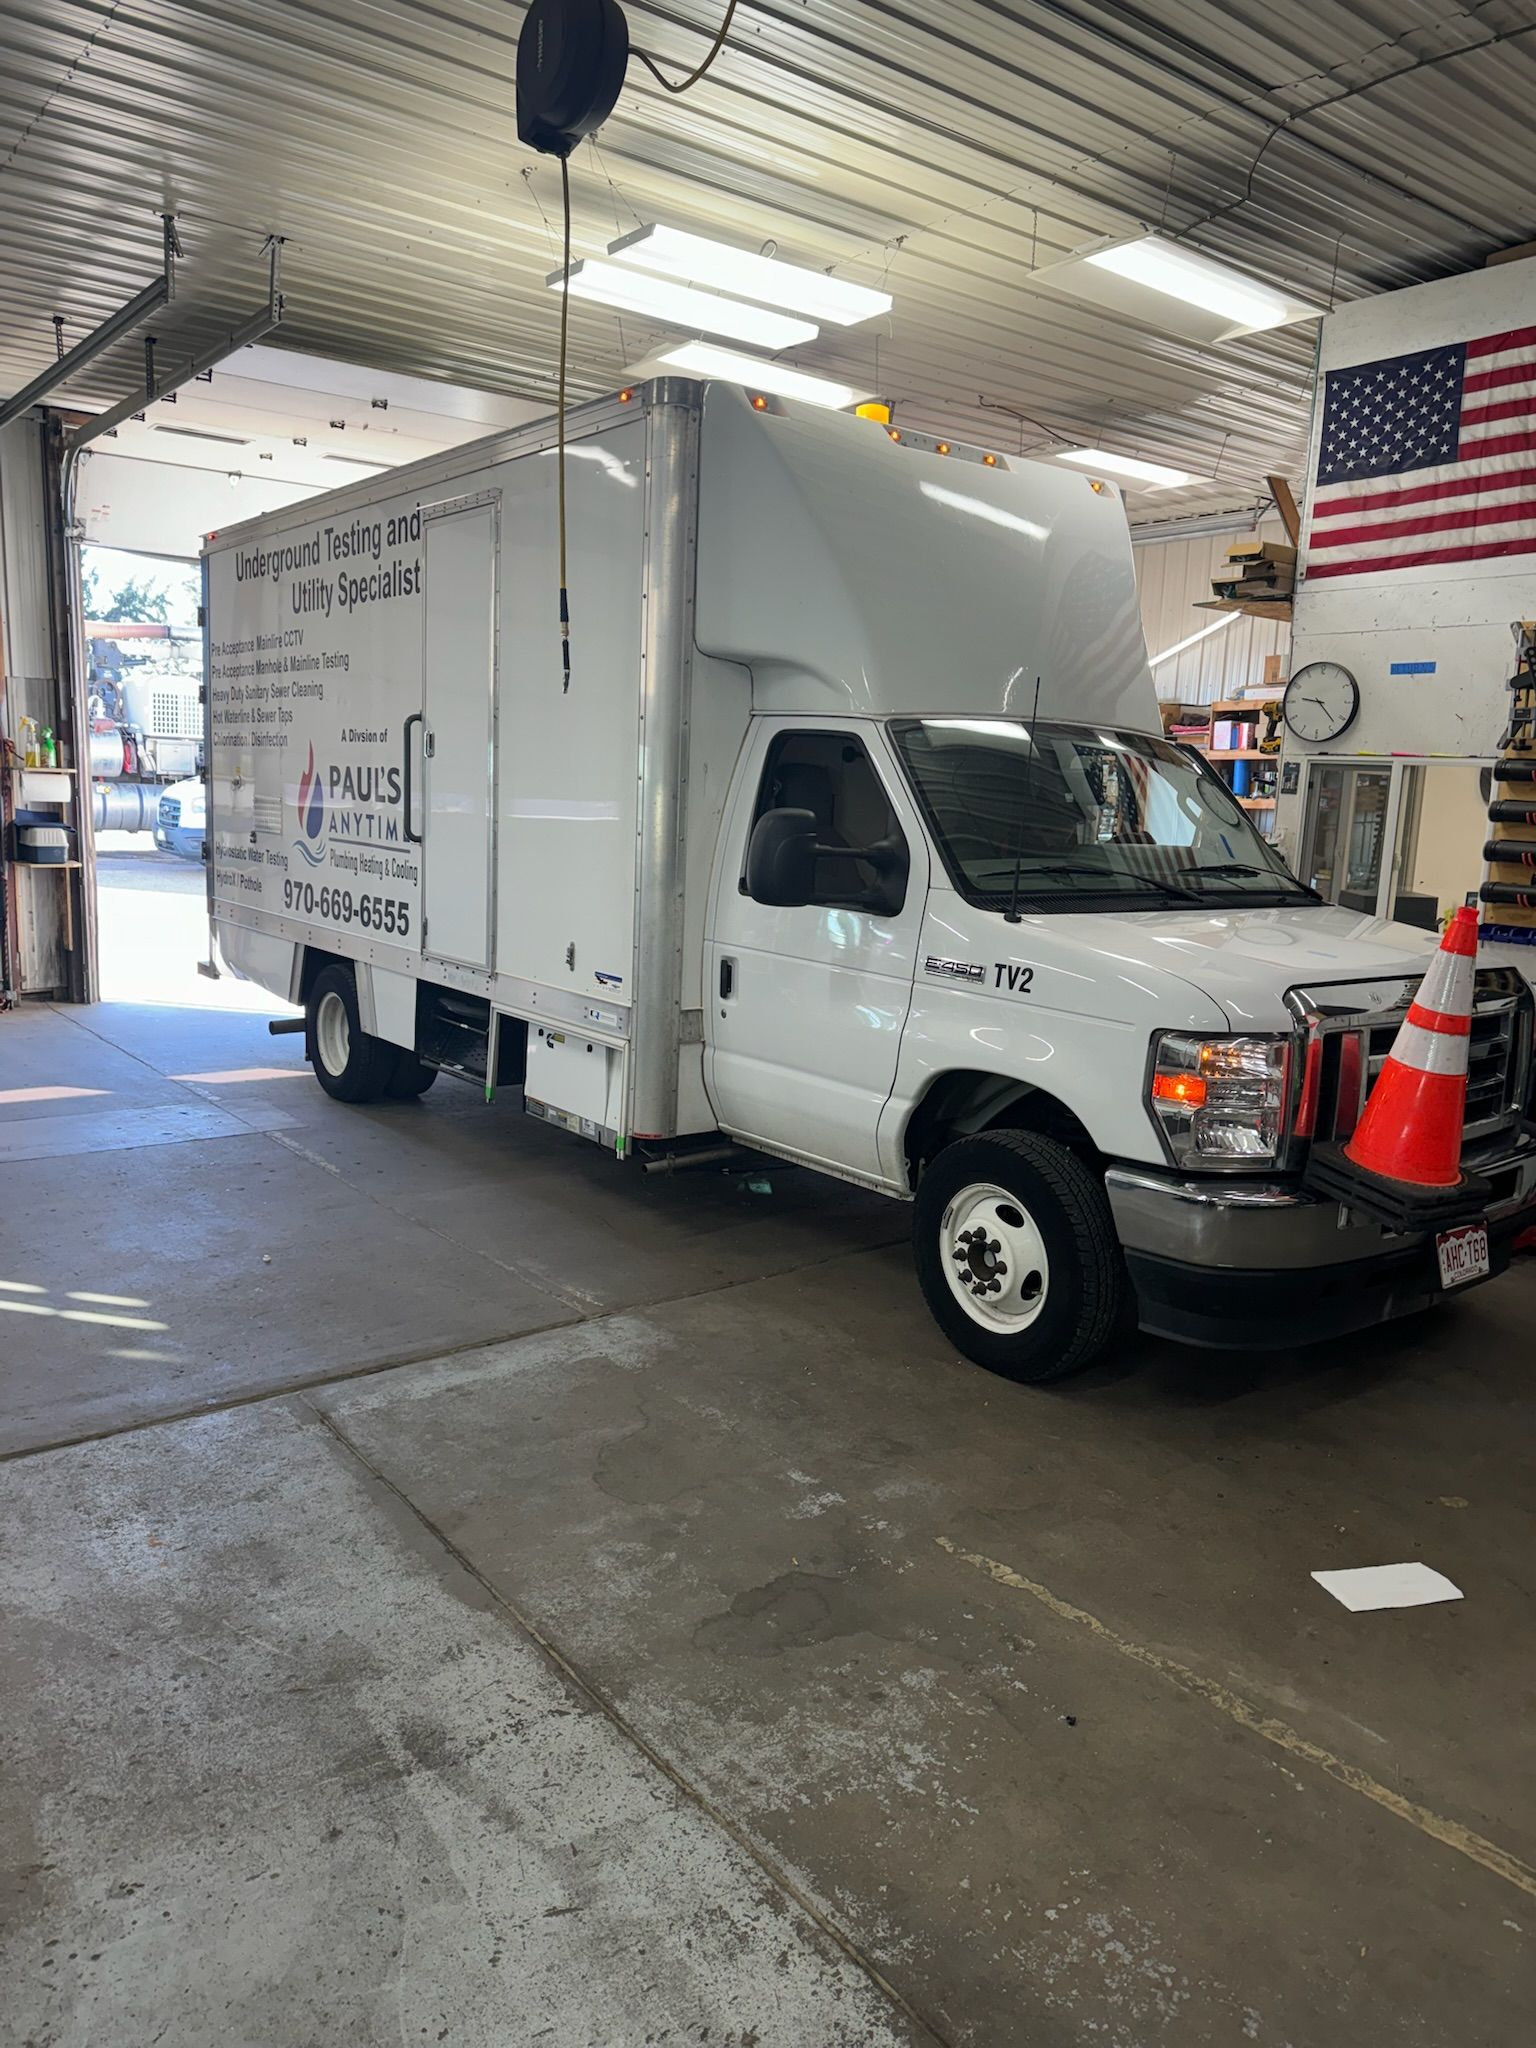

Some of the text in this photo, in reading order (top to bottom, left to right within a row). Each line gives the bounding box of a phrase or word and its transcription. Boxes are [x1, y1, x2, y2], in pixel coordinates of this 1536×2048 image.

[236, 502, 420, 582] Underground Testing and
[292, 558, 420, 618] Utility Specialist
[222, 640, 254, 657] Acceptance
[283, 629, 304, 647] CCTV
[222, 663, 255, 680] Acceptance
[256, 659, 282, 675] Manhole
[283, 657, 289, 673] &
[290, 654, 320, 672] Mainline
[322, 651, 349, 671] Testing
[213, 680, 324, 704] Heavy Duty Sanitary Sewer Cleaning
[224, 707, 250, 724] Waterline
[251, 707, 256, 723] &
[257, 707, 276, 723] Sewer
[278, 707, 293, 726] Taps
[251, 730, 288, 748] Disinfection
[341, 728, 347, 743] A
[380, 727, 388, 743] of
[329, 765, 402, 805] PAUL'S
[329, 811, 411, 843] ANYTIM
[248, 847, 264, 863] Water
[266, 849, 288, 871] Testing
[330, 848, 418, 887] Plumbing Heating & Cooling
[240, 874, 262, 893] Pothole
[284, 879, 409, 936] 970-669-6555
[995, 963, 1034, 993] TV2
